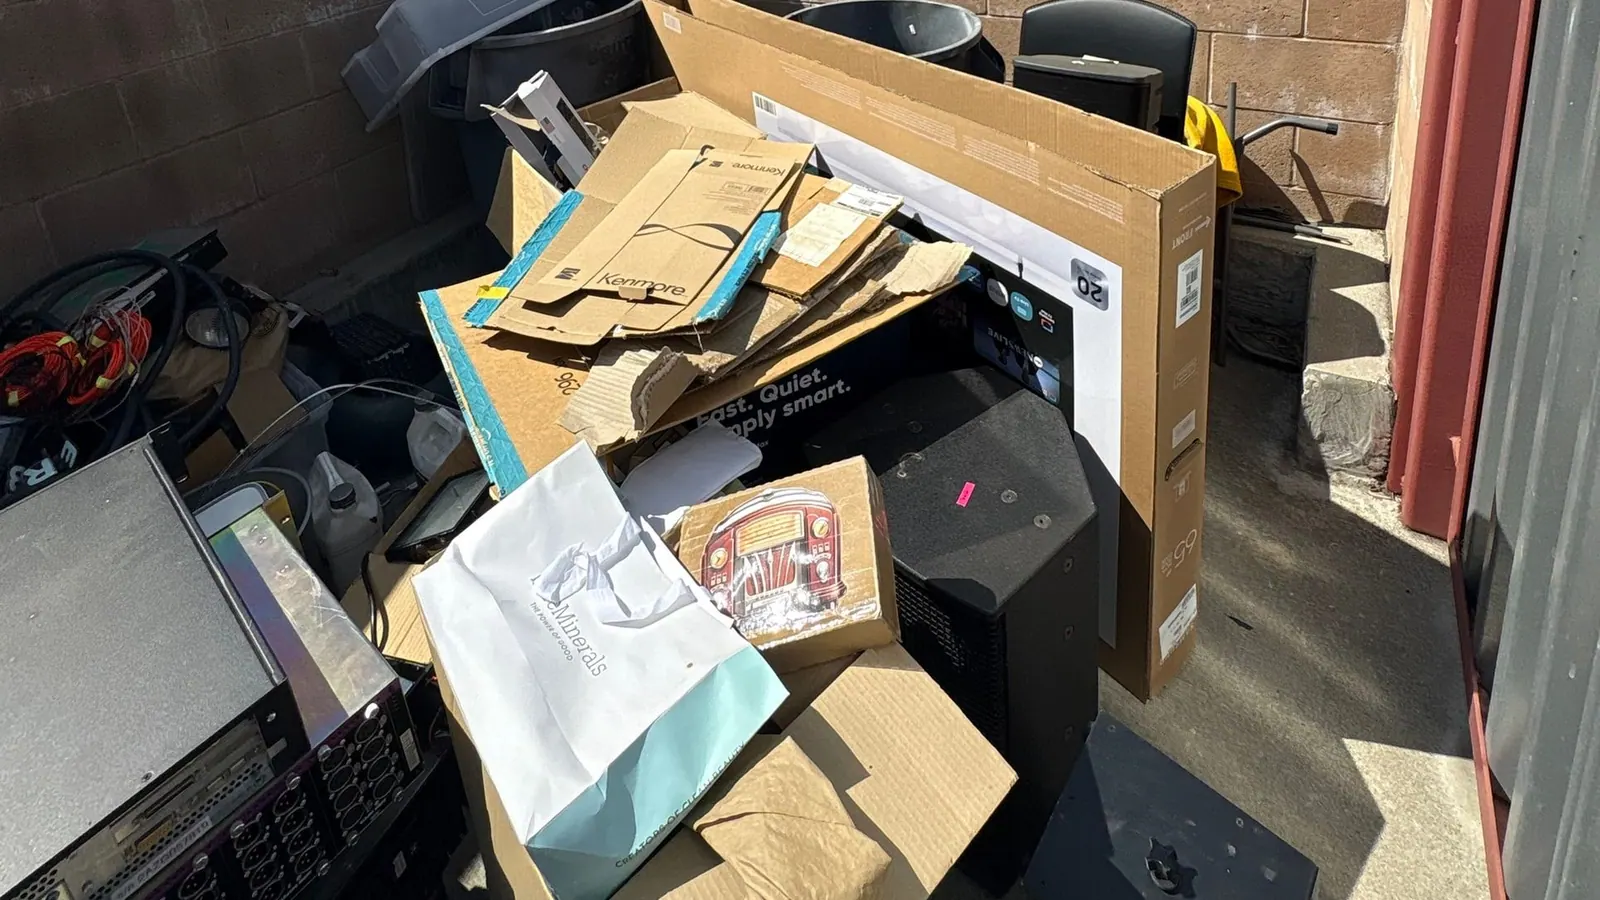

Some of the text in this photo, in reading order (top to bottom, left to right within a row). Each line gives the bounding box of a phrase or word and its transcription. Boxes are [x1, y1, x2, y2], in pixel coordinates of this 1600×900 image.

[732, 162, 786, 176] Kenmore
[1172, 228, 1193, 250] FRONT
[596, 272, 686, 296] Kenmore
[1077, 276, 1103, 303] 20
[760, 368, 828, 404] Quiet.
[783, 379, 851, 417] smart.
[1174, 529, 1197, 568] 65
[547, 601, 607, 677] eMinerals
[615, 823, 667, 868] CREATORS
